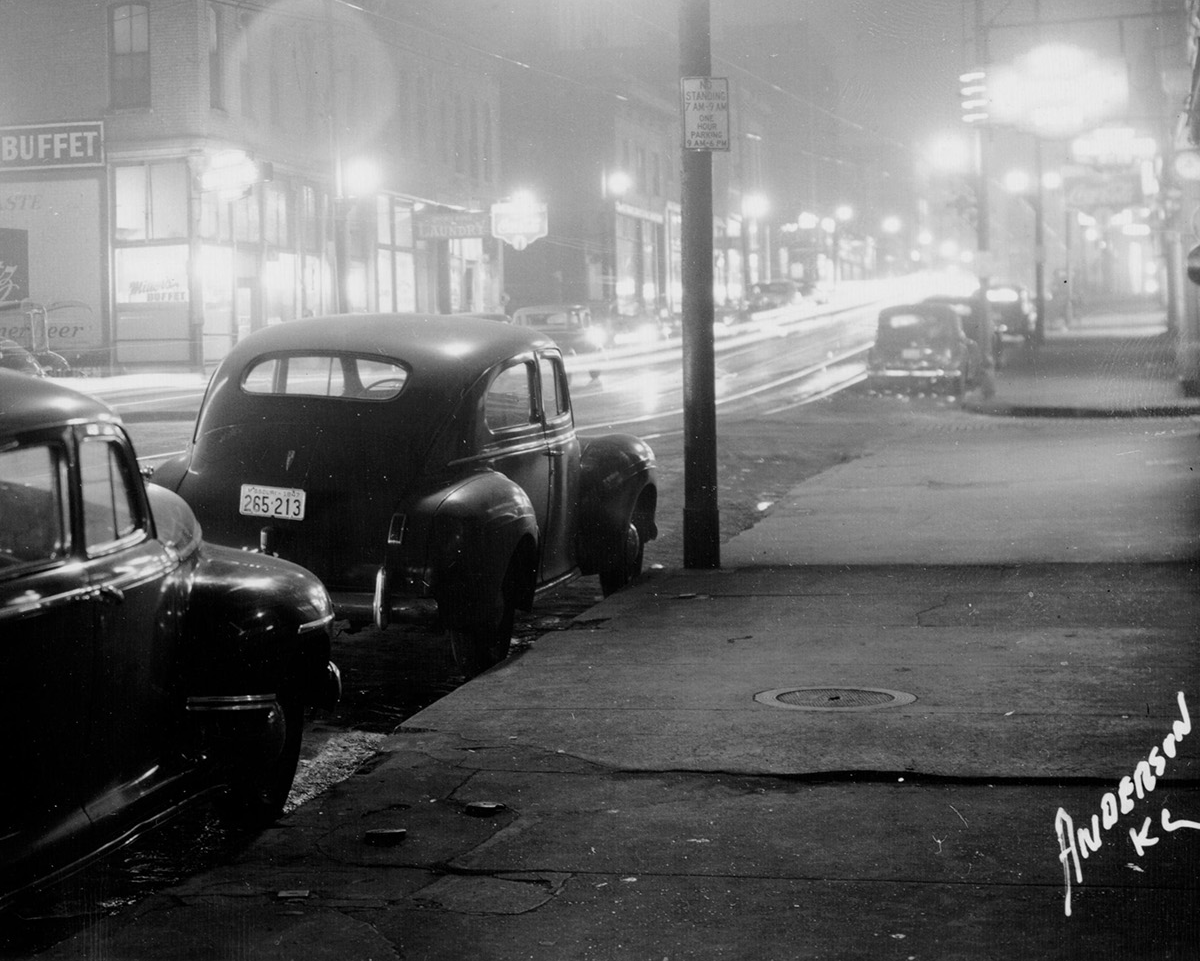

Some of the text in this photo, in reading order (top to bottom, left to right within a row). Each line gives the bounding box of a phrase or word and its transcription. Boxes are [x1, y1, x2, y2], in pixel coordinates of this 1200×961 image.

[700, 80, 712, 90] NO
[685, 91, 726, 101] STANDING
[685, 102, 691, 111] 7
[699, 114, 713, 122] ONE
[697, 122, 717, 130] HOUR
[690, 131, 723, 139] PARKING
[2, 130, 99, 161] BUFFET
[417, 220, 486, 238] LAUNDRY
